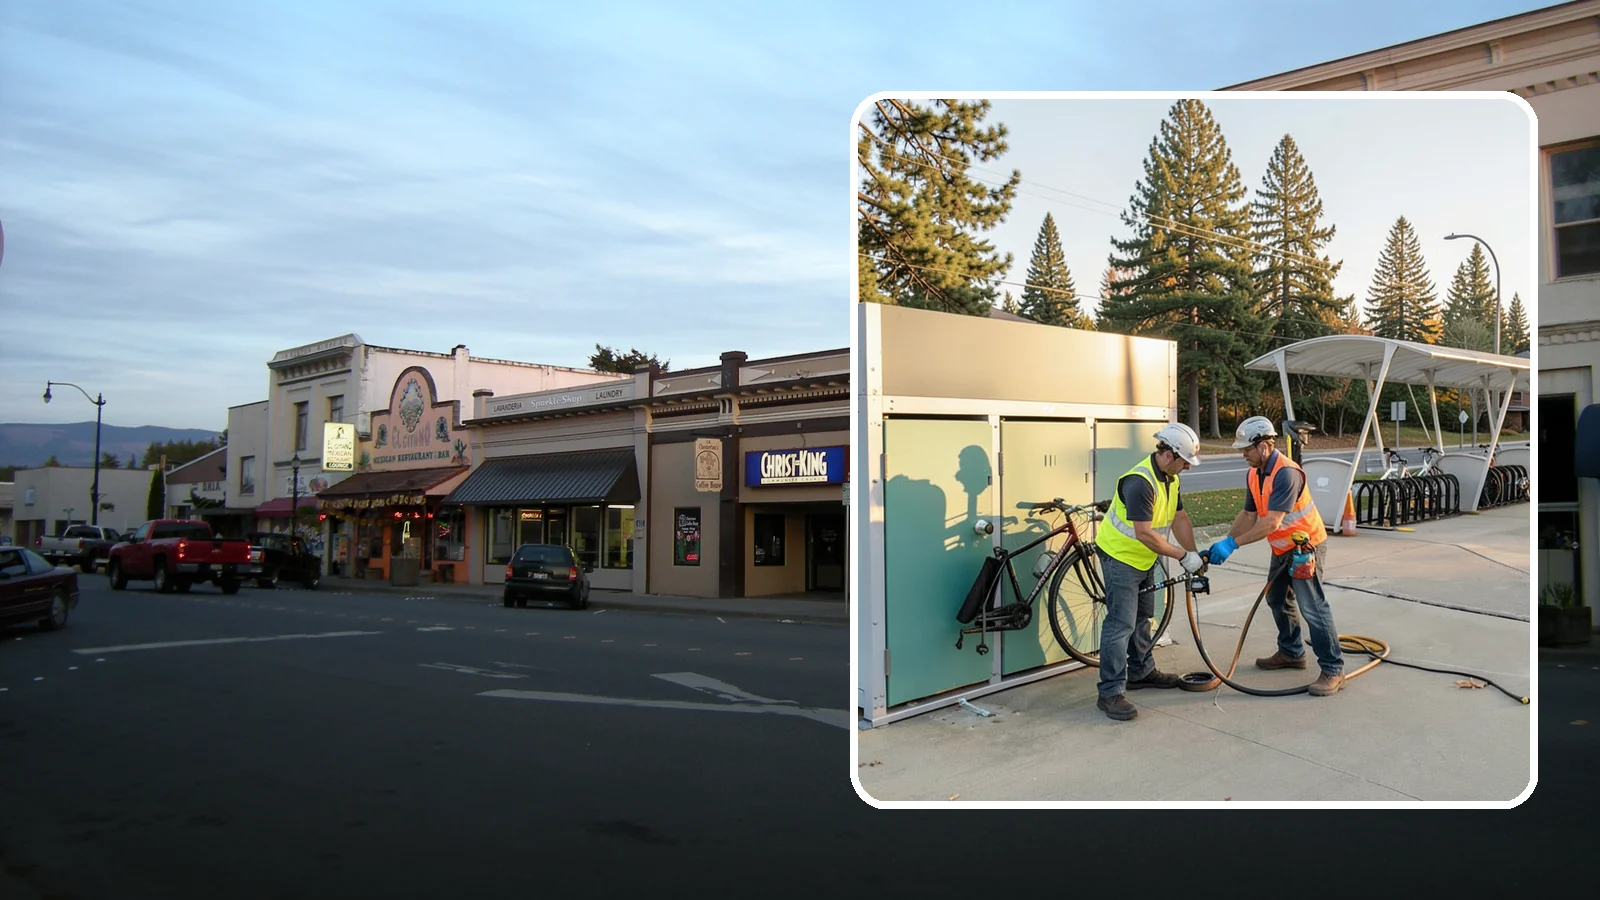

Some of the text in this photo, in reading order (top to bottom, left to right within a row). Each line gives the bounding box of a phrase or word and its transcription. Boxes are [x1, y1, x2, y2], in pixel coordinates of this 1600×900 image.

[595, 389, 623, 399] LAUNDRY
[493, 402, 522, 412] LAVANDERIA
[531, 394, 582, 409] Sparkle Shop
[397, 451, 433, 462] RESTAURANT
[438, 450, 450, 459] BAR
[761, 450, 827, 478] CHRIST KING
